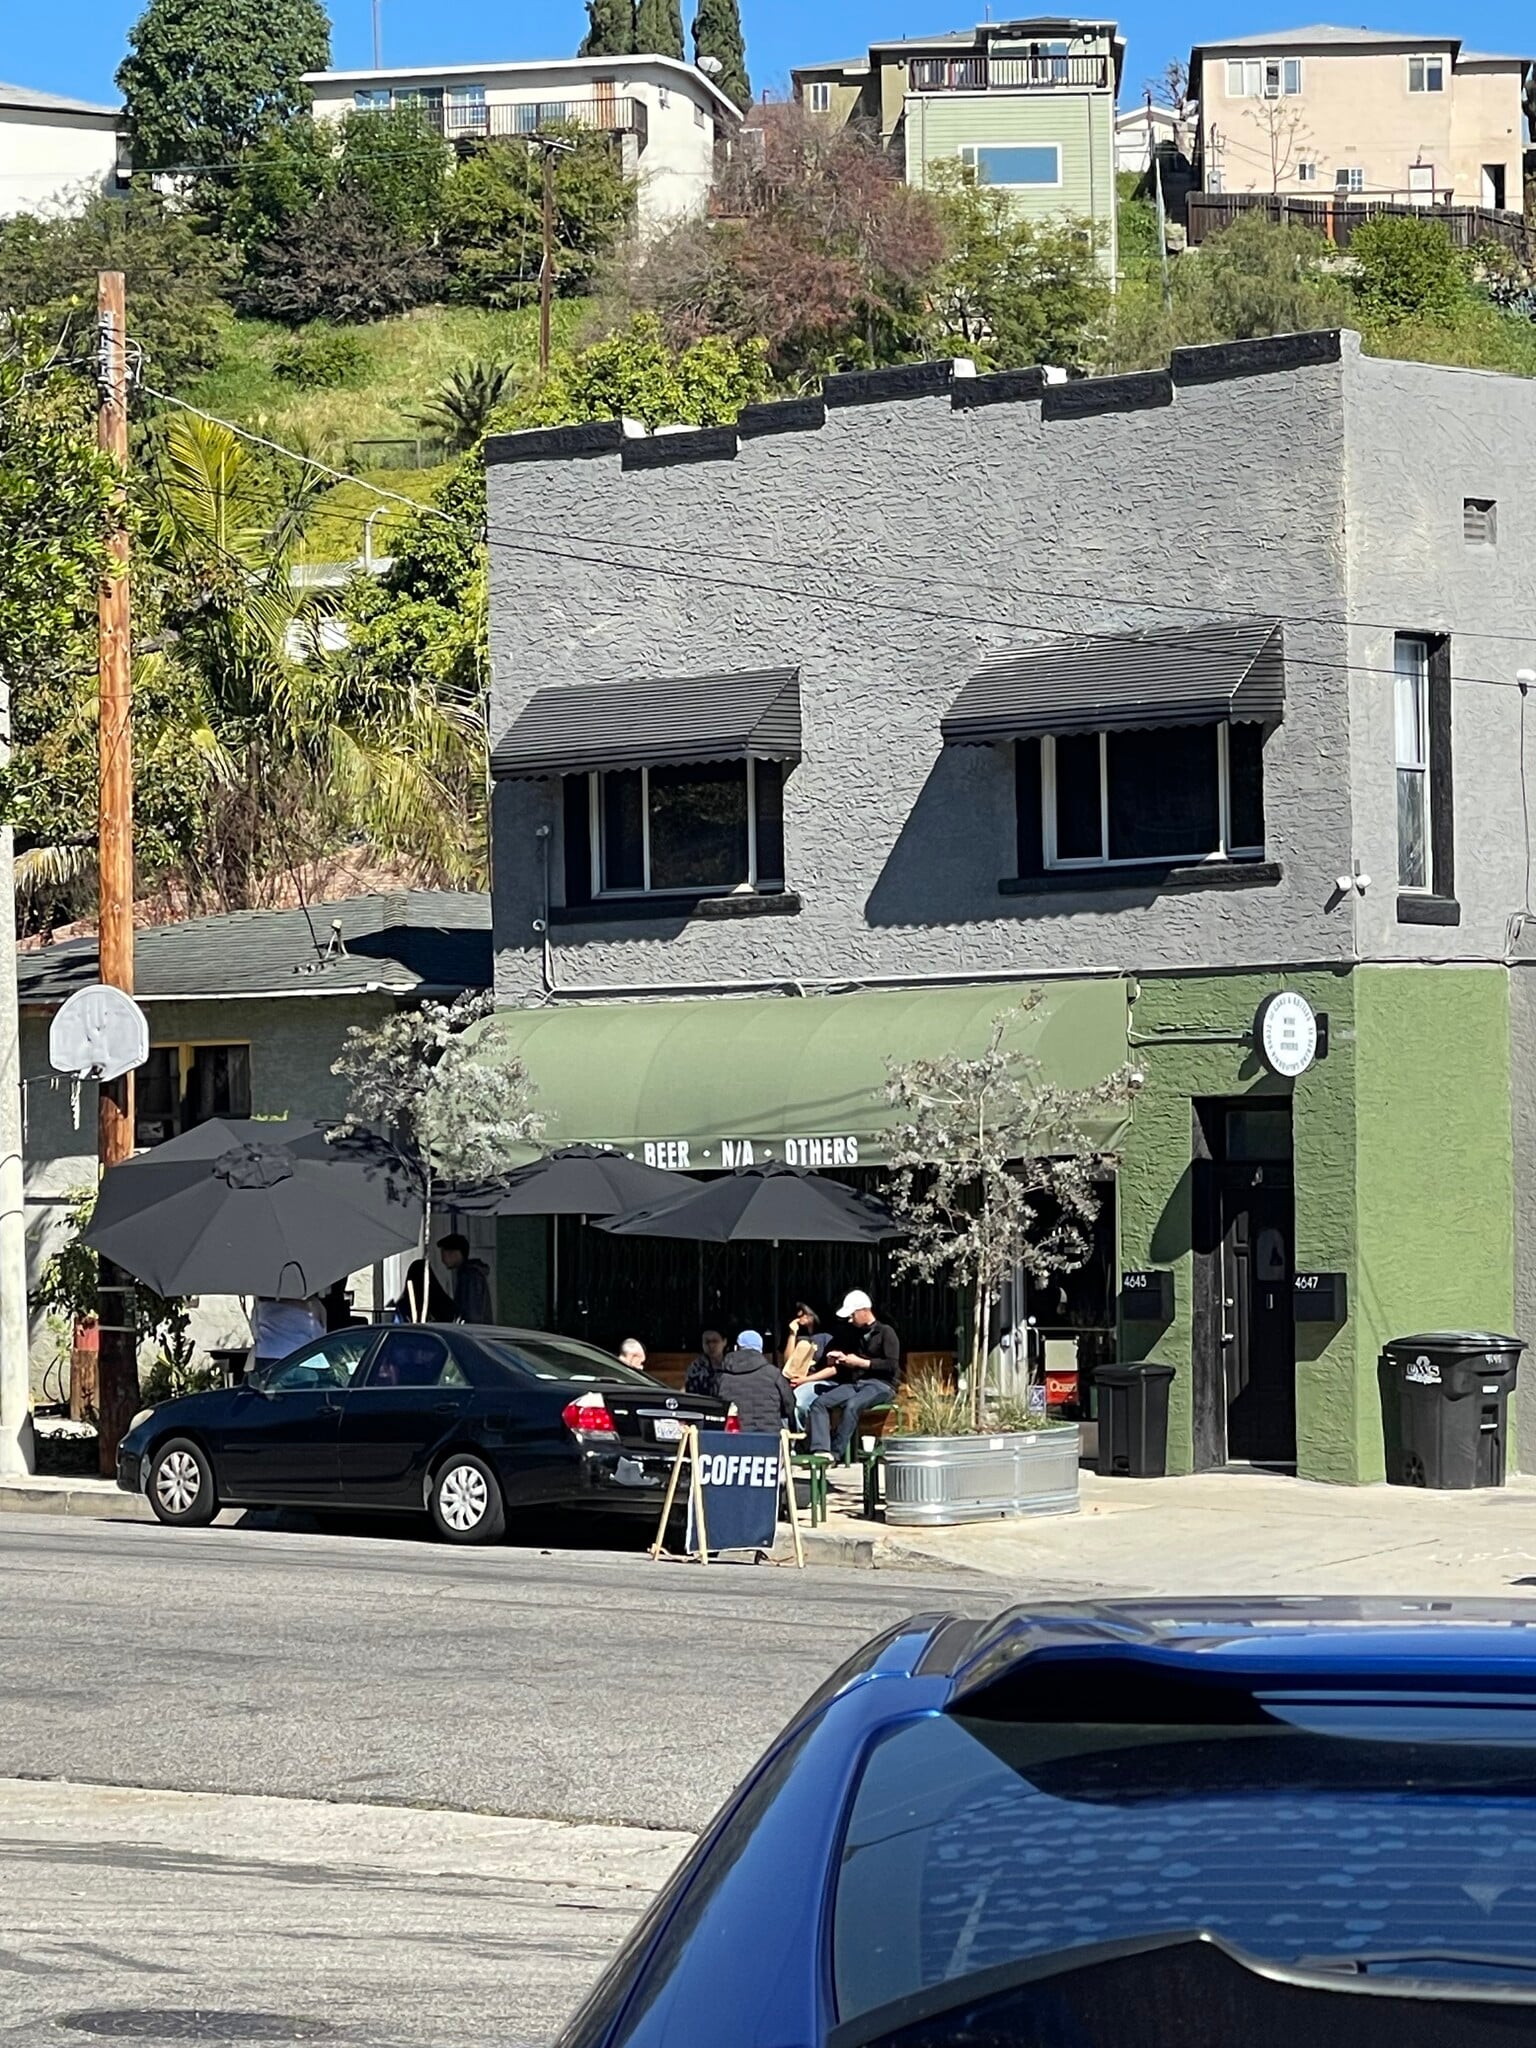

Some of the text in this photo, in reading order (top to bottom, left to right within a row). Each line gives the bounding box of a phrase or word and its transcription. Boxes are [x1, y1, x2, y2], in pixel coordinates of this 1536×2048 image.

[644, 1136, 858, 1168] BEER N/A OTHERS
[1124, 1274, 1147, 1288] 4645
[1295, 1276, 1319, 1289] 4647
[699, 1454, 778, 1487] COFFEE
